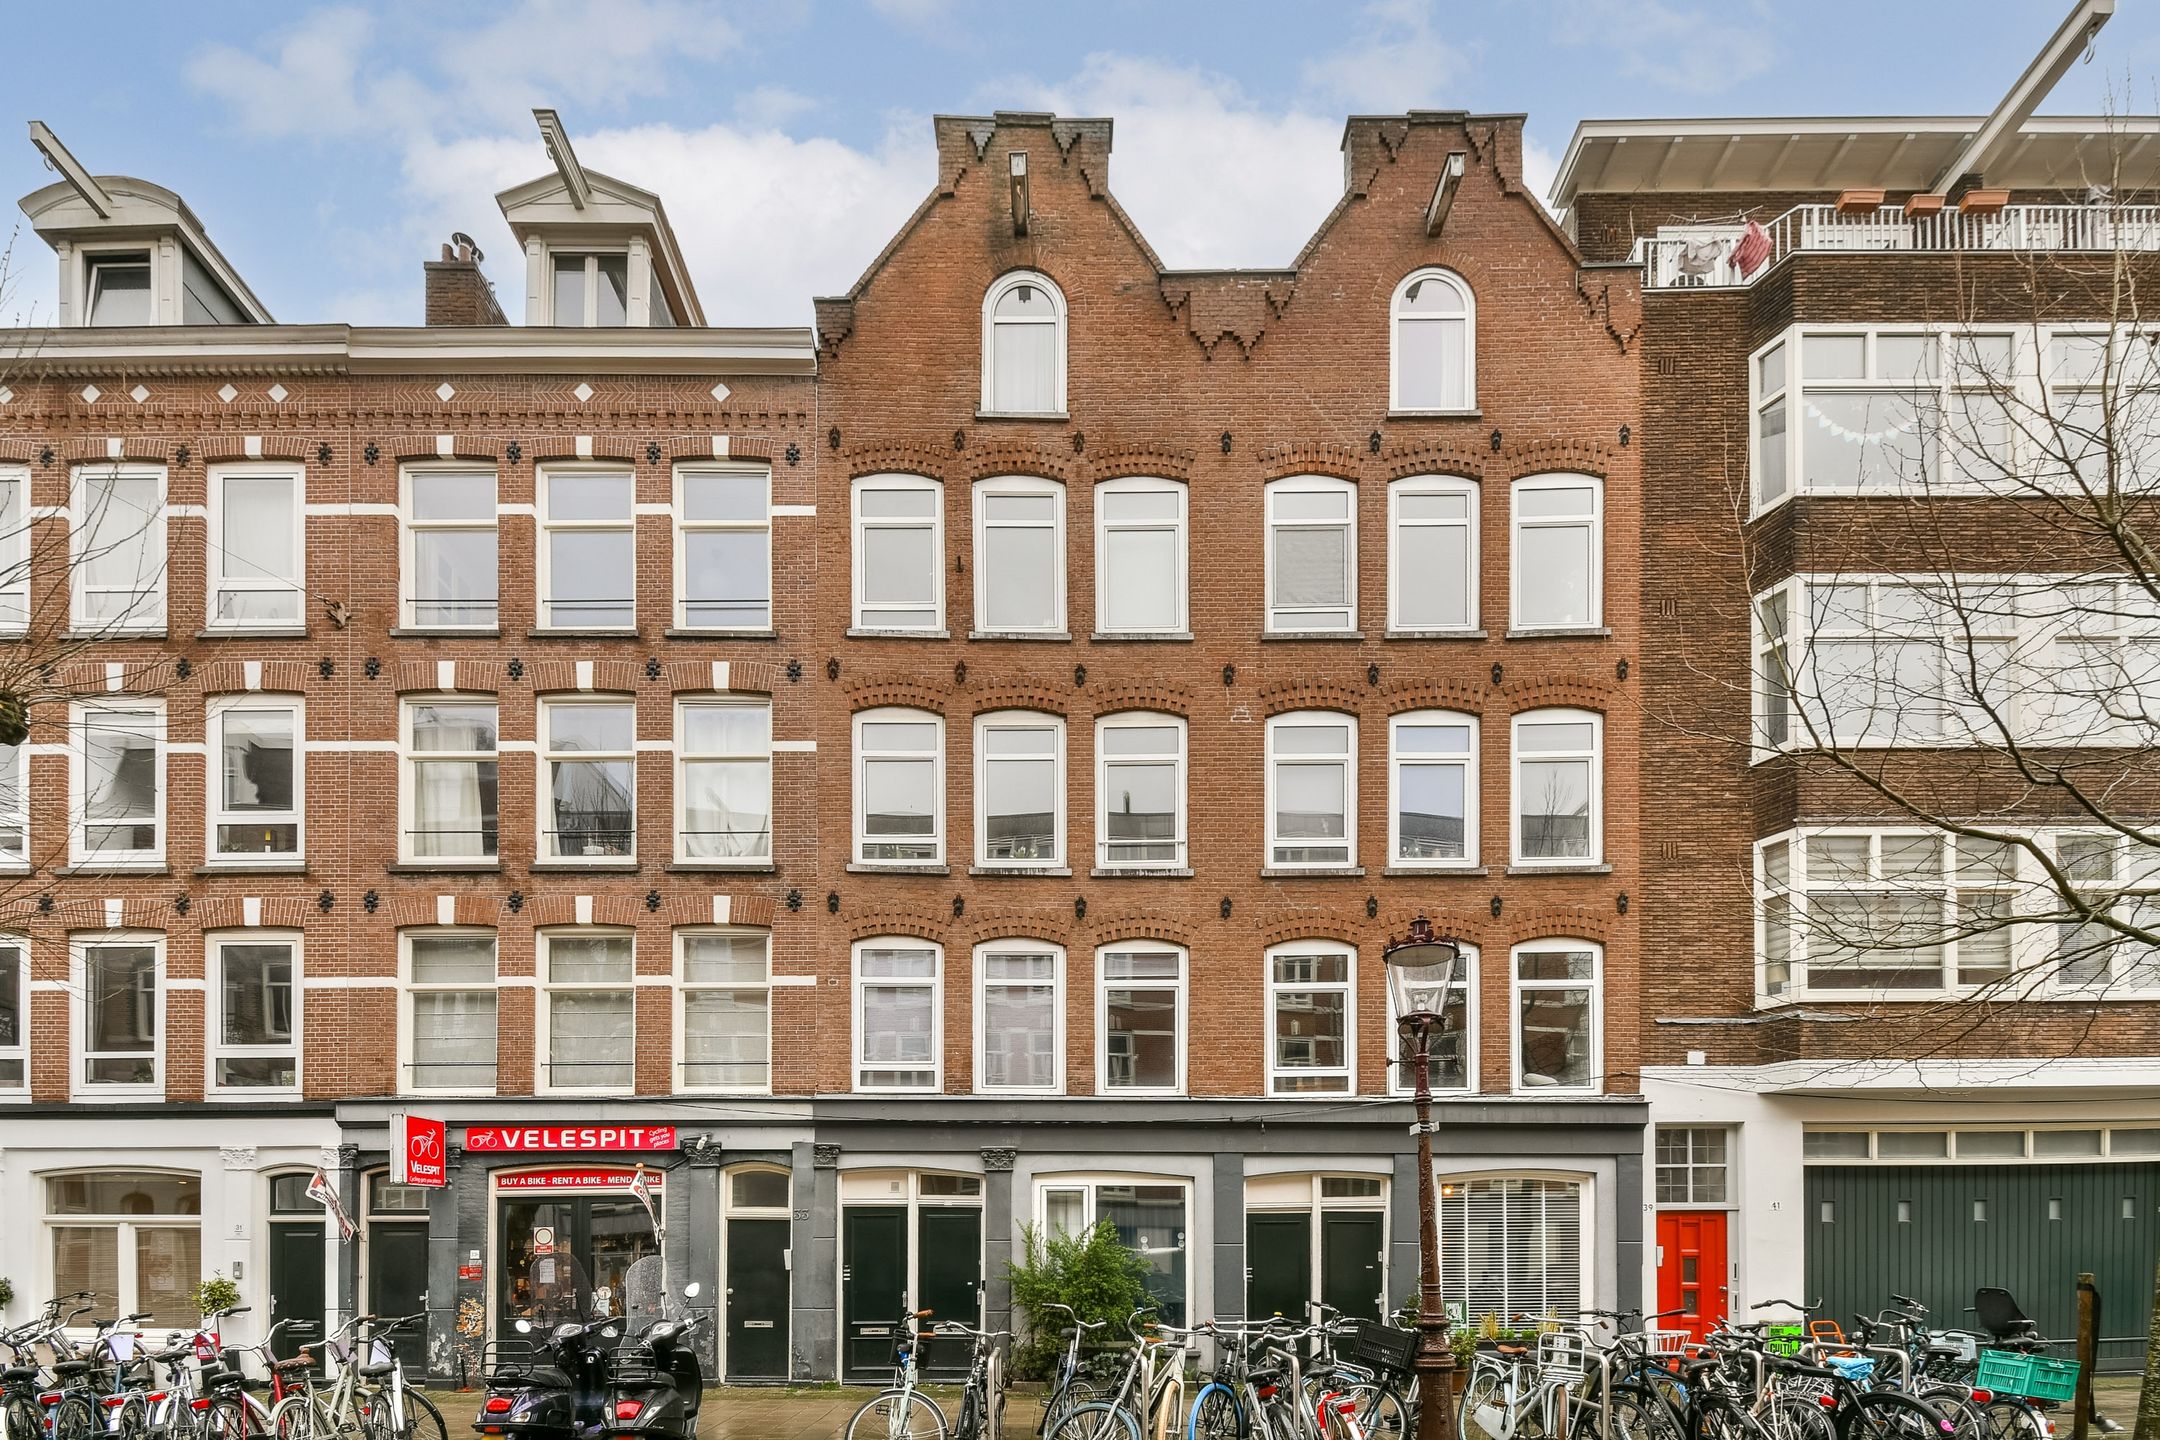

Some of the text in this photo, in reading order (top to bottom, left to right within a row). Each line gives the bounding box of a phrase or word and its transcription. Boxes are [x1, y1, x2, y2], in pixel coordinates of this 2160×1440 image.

[649, 1127, 667, 1137] Cycling
[501, 1129, 645, 1148] VELESPIT
[501, 1177, 518, 1185] BUY
[520, 1177, 526, 1185] A
[527, 1177, 546, 1185] BIKE
[552, 1177, 573, 1185] RENT
[575, 1177, 581, 1185] A
